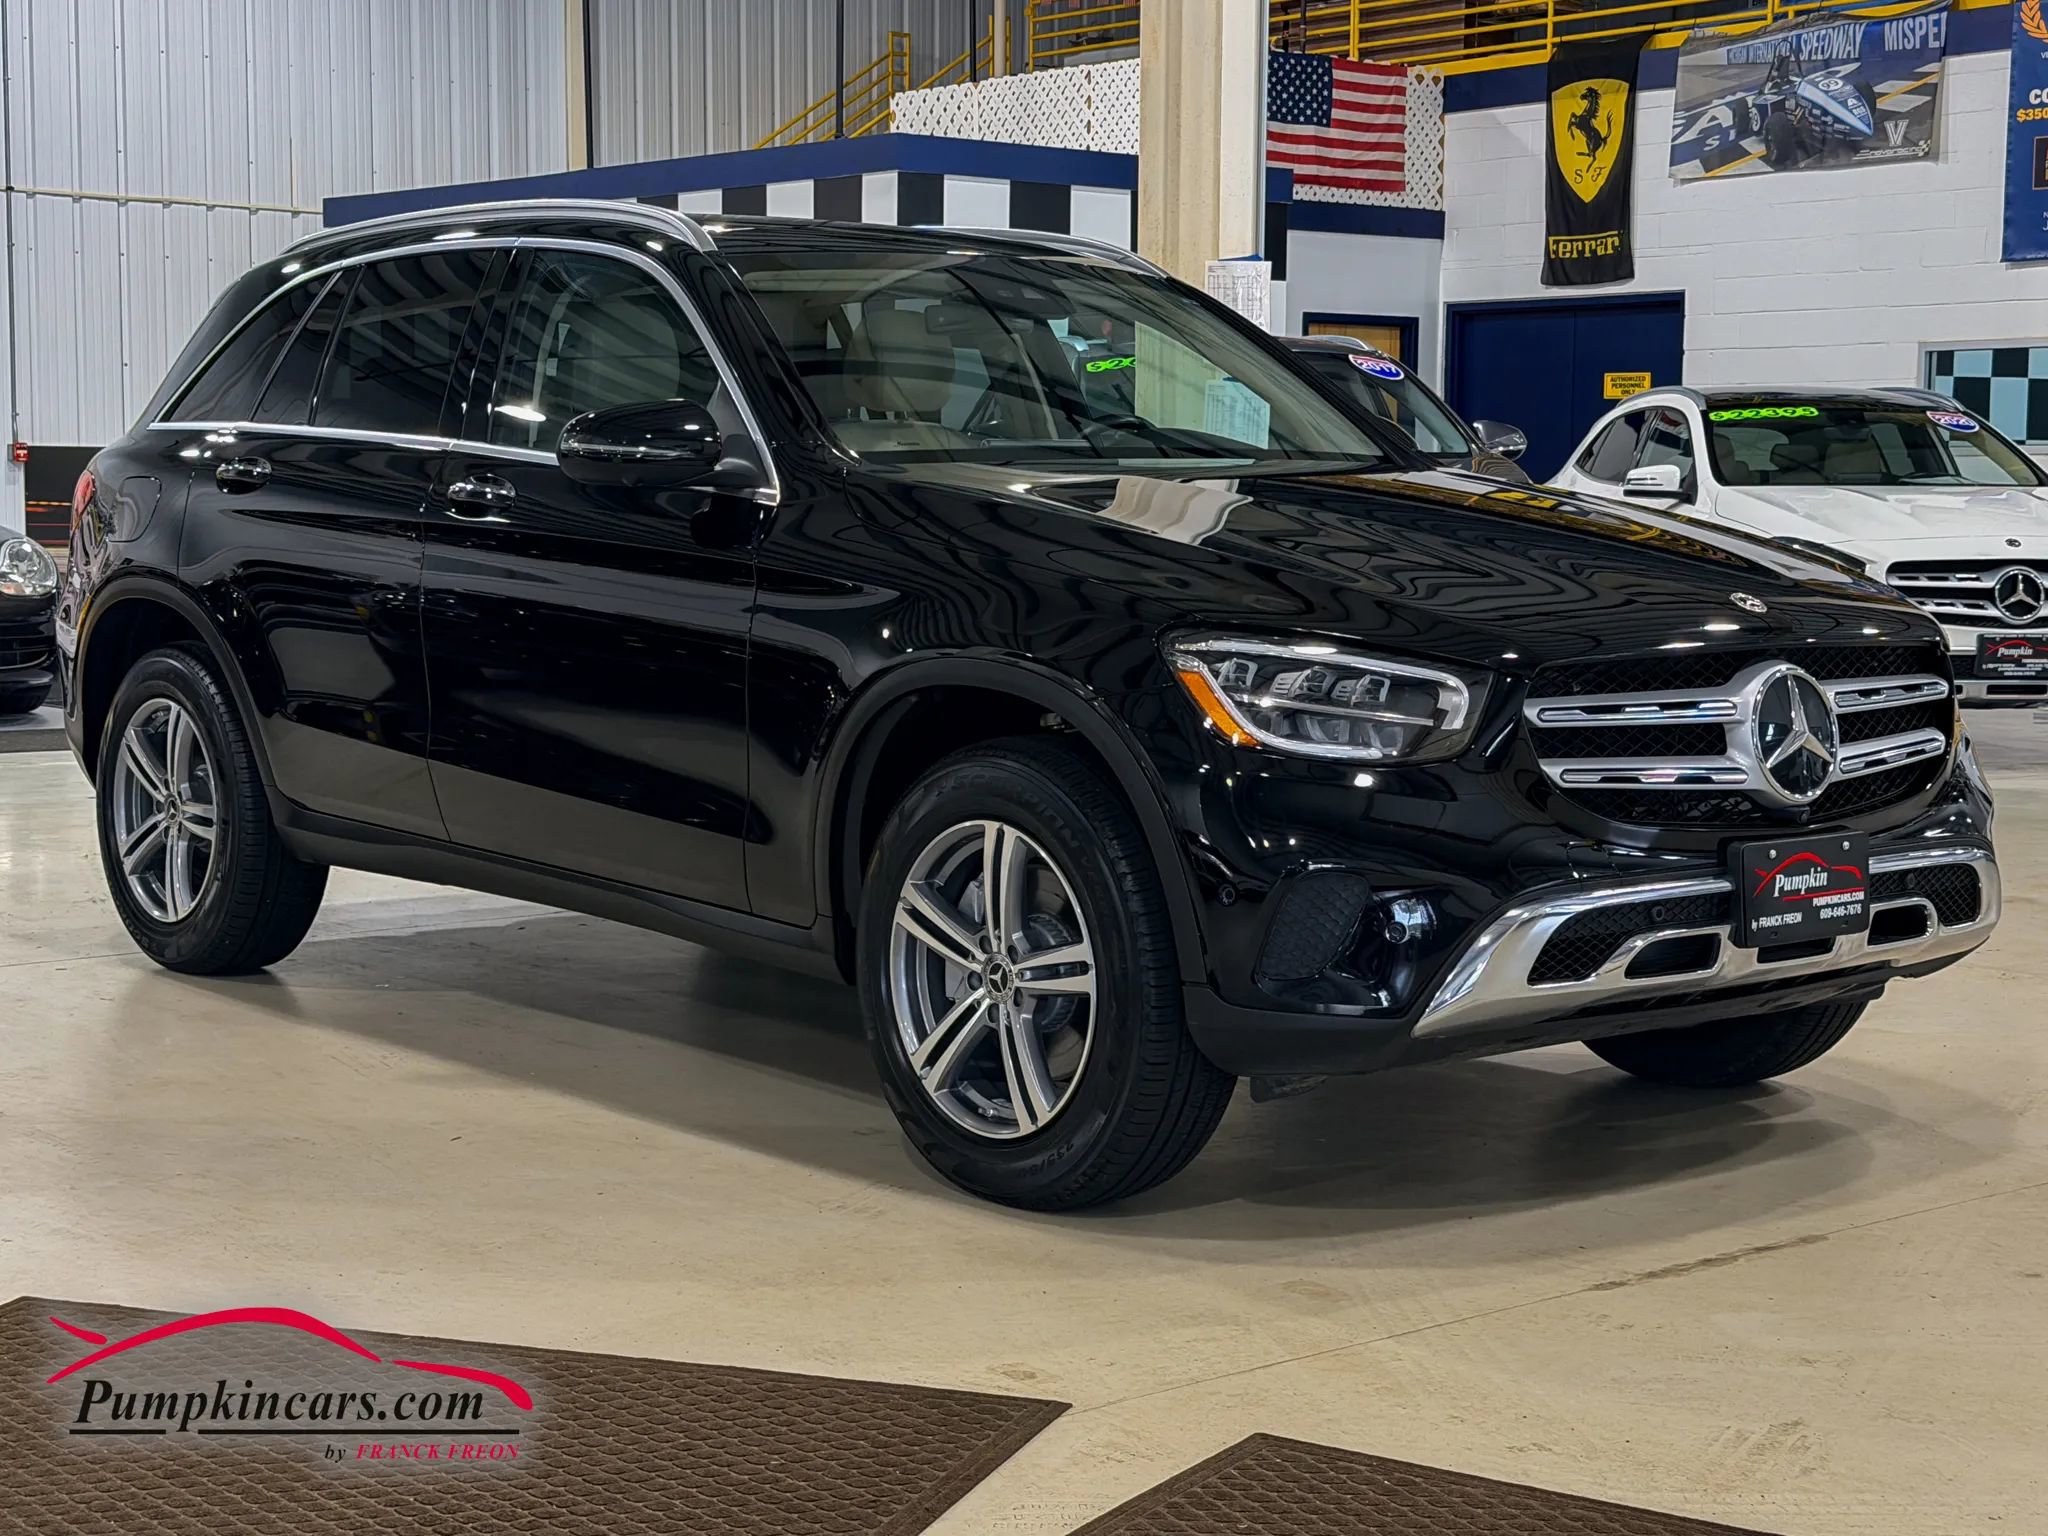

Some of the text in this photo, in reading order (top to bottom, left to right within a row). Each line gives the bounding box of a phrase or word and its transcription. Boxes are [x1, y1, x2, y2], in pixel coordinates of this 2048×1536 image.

[1800, 22, 1867, 60] SPEEDWAY
[1574, 168, 1584, 184] S
[1997, 646, 2033, 658] Pumpkin
[1773, 866, 1829, 898] Pumpkin
[1812, 890, 1865, 908] PUMPKINCARS.COM
[1820, 903, 1862, 920] 609-646-7676
[1751, 911, 1803, 932] by FRANCK FREON
